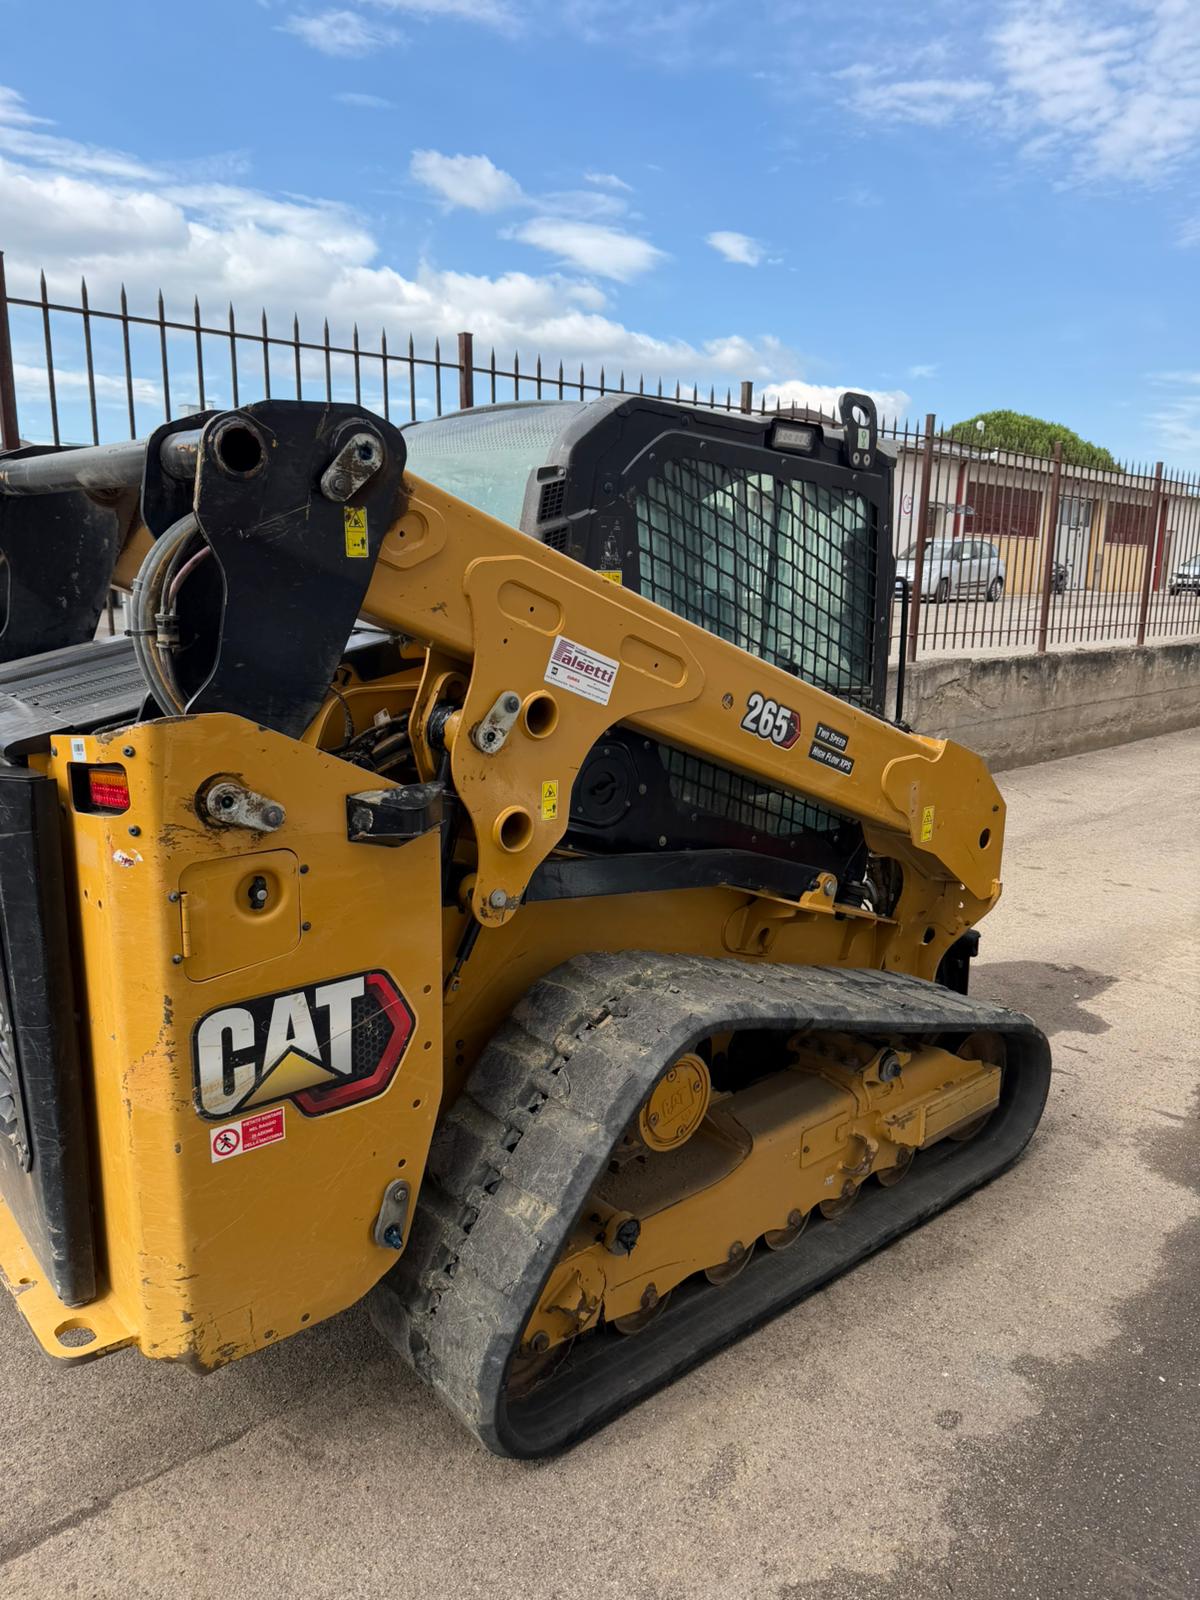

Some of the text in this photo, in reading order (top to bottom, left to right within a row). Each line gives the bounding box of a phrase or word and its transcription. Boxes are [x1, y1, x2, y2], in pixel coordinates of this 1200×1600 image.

[552, 639, 614, 683] Falsetti
[742, 693, 792, 742] 265
[829, 733, 846, 747] SPEED
[839, 759, 852, 770] XPS
[198, 976, 364, 1115] CAT
